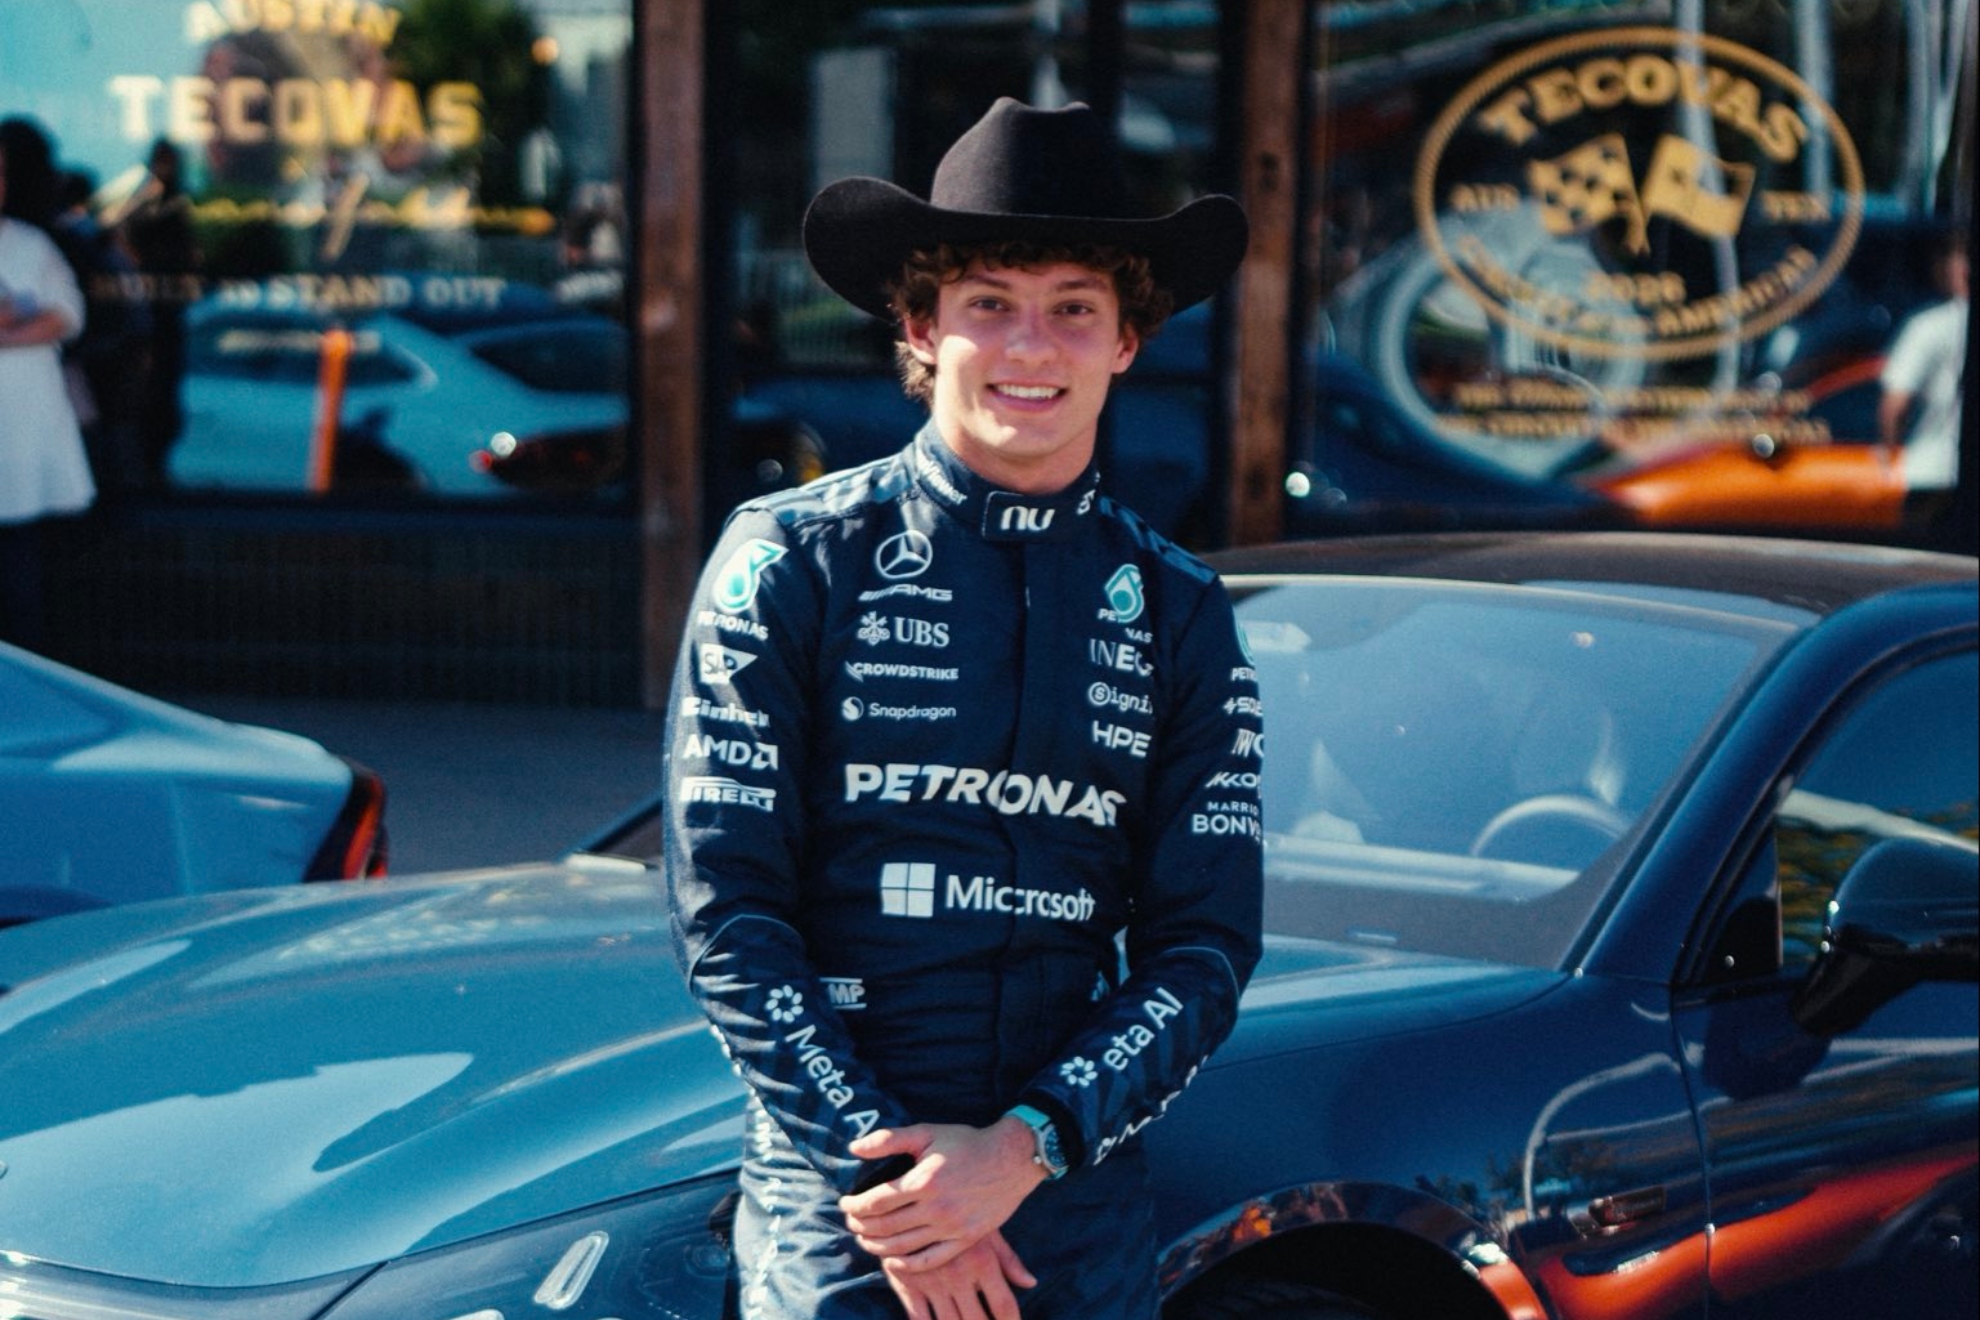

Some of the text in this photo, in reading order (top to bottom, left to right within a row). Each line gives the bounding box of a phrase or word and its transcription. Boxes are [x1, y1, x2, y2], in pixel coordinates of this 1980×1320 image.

[108, 74, 485, 150] TECOVAS
[1478, 54, 1809, 163] TECOVAS
[266, 274, 411, 310] STAND
[423, 276, 508, 309] OUT
[889, 583, 953, 601] AMG
[894, 616, 950, 647] UBS
[853, 662, 959, 680] CROWDSTRIKE
[868, 702, 957, 721] Snapdragon
[682, 734, 752, 766] AMD
[1092, 720, 1152, 758] HPE
[844, 763, 1127, 827] PETRONAS
[827, 983, 866, 1004] MP
[1102, 1023, 1155, 1071] eta
[1142, 986, 1184, 1030] AI
[785, 1024, 881, 1139] Meta A
